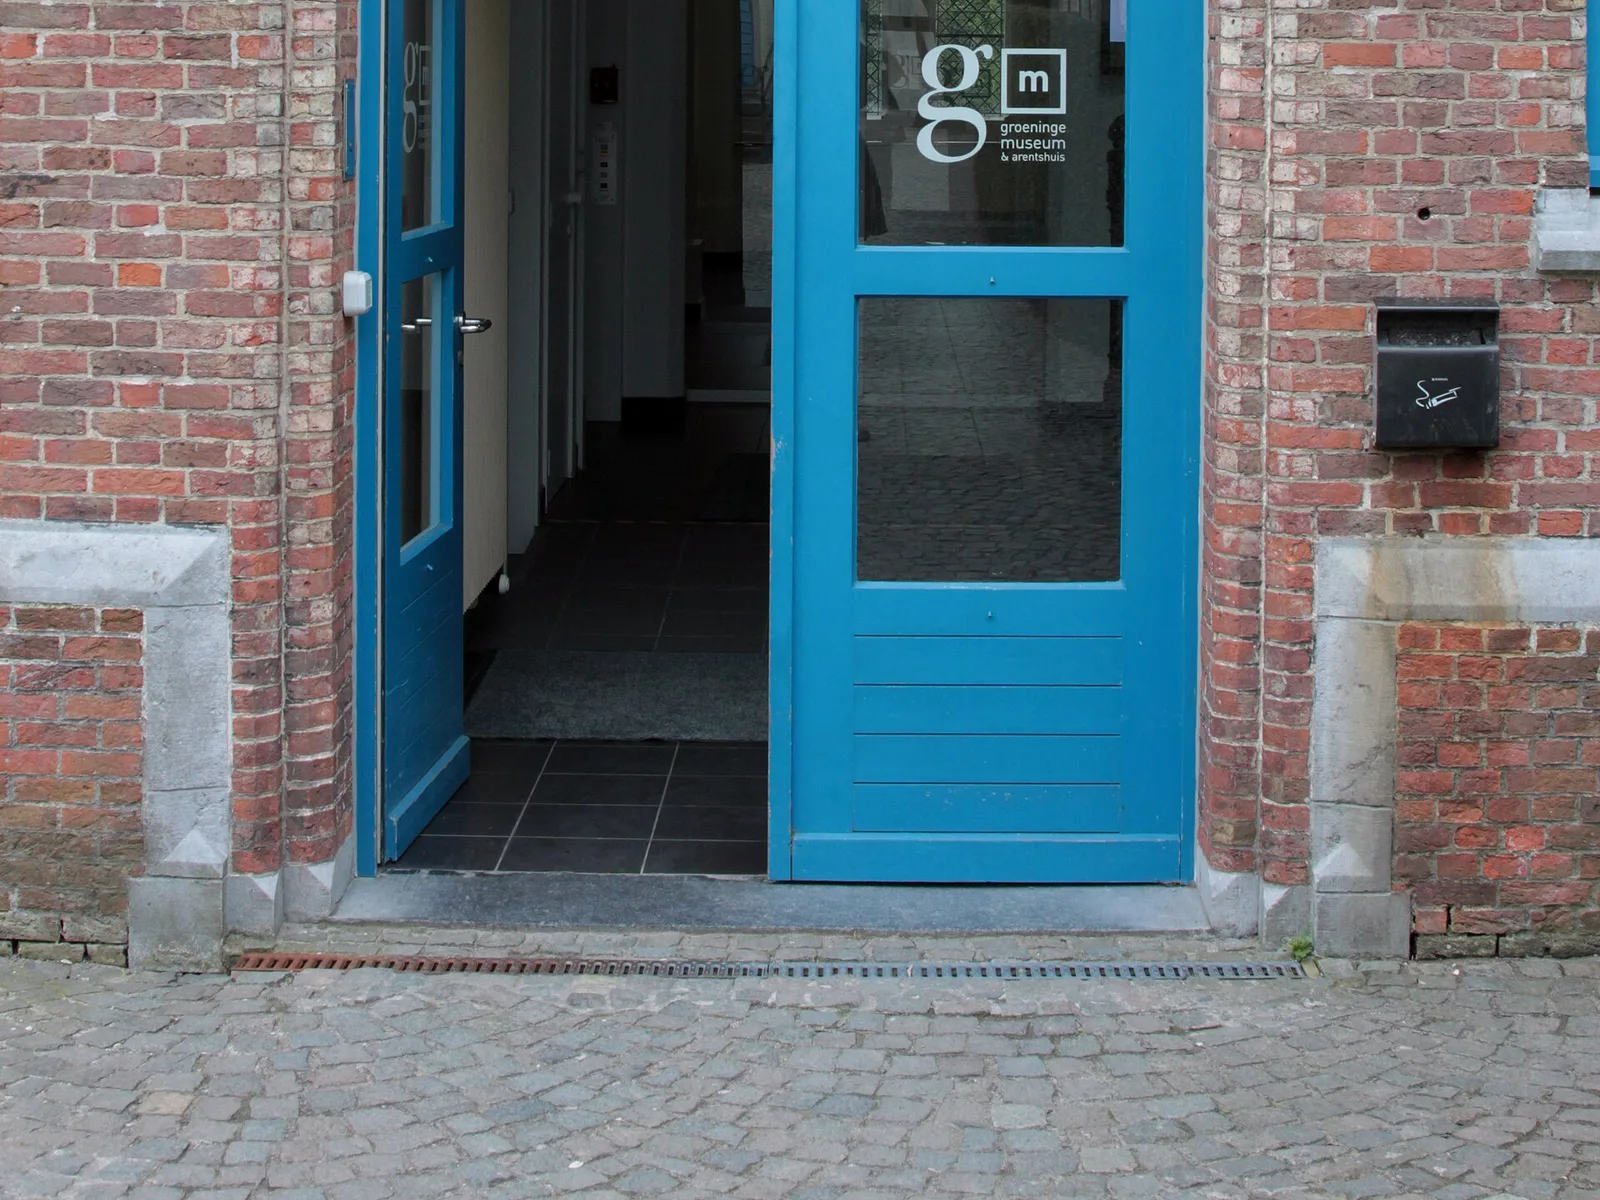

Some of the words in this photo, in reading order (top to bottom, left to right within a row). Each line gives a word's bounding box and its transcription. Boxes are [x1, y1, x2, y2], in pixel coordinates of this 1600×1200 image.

[1018, 70, 1049, 92] m
[1000, 120, 1067, 136] groeninge
[1000, 138, 1066, 150] museum
[1001, 152, 1009, 162] &
[1011, 152, 1066, 162] arentshuis
